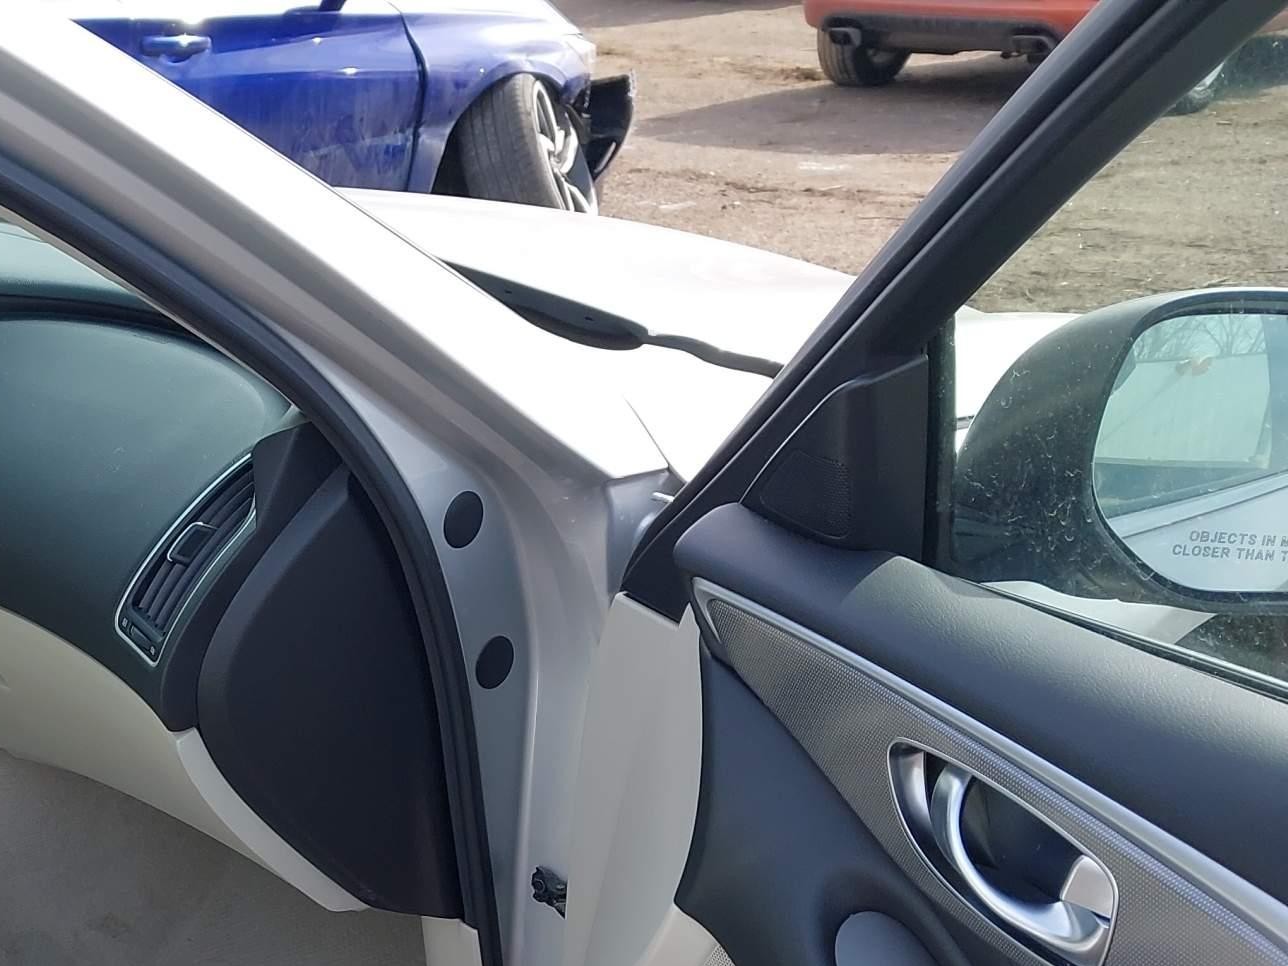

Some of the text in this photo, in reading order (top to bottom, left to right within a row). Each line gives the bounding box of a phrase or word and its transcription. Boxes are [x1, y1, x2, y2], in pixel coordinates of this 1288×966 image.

[1189, 530, 1258, 546] OBJECTS
[1261, 535, 1277, 547] IN
[1172, 544, 1231, 558] CLOSER
[1236, 547, 1275, 561] THAN
